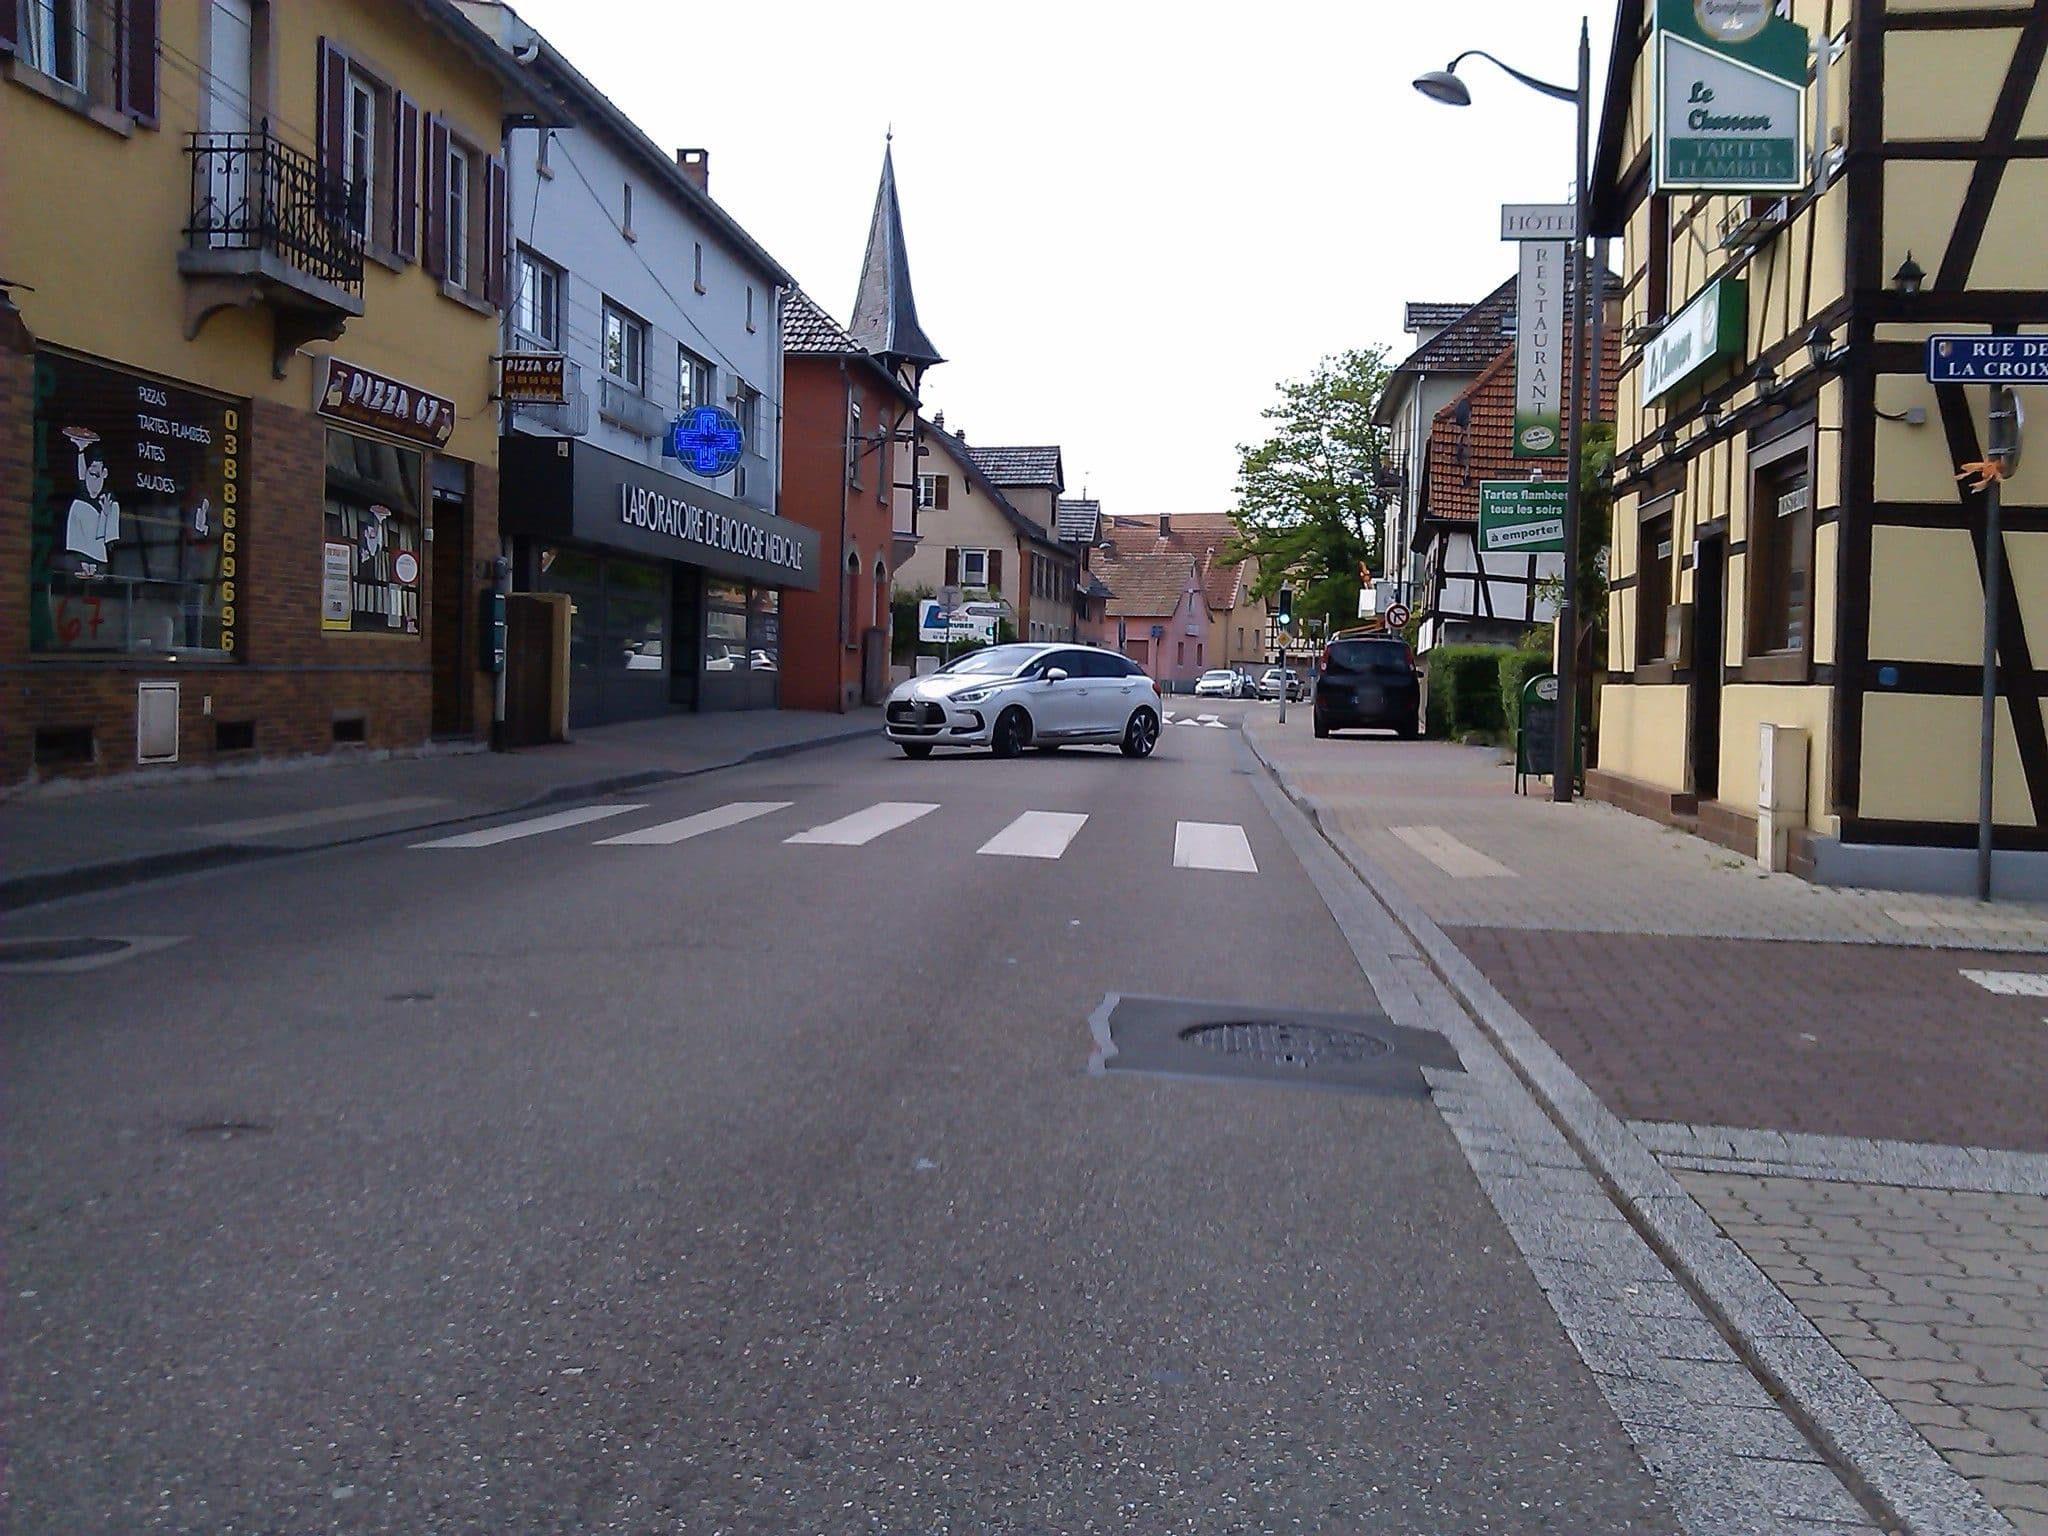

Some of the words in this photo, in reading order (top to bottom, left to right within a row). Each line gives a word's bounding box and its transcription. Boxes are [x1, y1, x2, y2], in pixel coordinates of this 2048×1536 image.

[1695, 141, 1773, 158] TARTES
[1531, 247, 1548, 416] RESTAURANT
[1972, 342, 2015, 357] RUE
[2023, 342, 2048, 357] DE
[505, 359, 542, 373] PIZZA
[546, 360, 561, 373] 67
[1948, 362, 1976, 376] LA
[1983, 361, 2048, 377] CROIX
[138, 386, 168, 407] PIZZAS
[347, 372, 410, 419] PIZZA
[415, 395, 440, 427] 67
[137, 414, 170, 436] TARTES
[136, 472, 176, 494] SALADES
[1483, 489, 1519, 500] Tartes
[1490, 504, 1514, 515] tous
[1516, 503, 1533, 515] les
[1535, 503, 1563, 515] soirs
[621, 482, 704, 544] LABORATOIRE
[704, 510, 720, 548] DE
[721, 516, 764, 561] BIOLOGIE
[1491, 532, 1499, 542] à
[1502, 525, 1559, 540] emporter
[54, 595, 105, 643] 67
